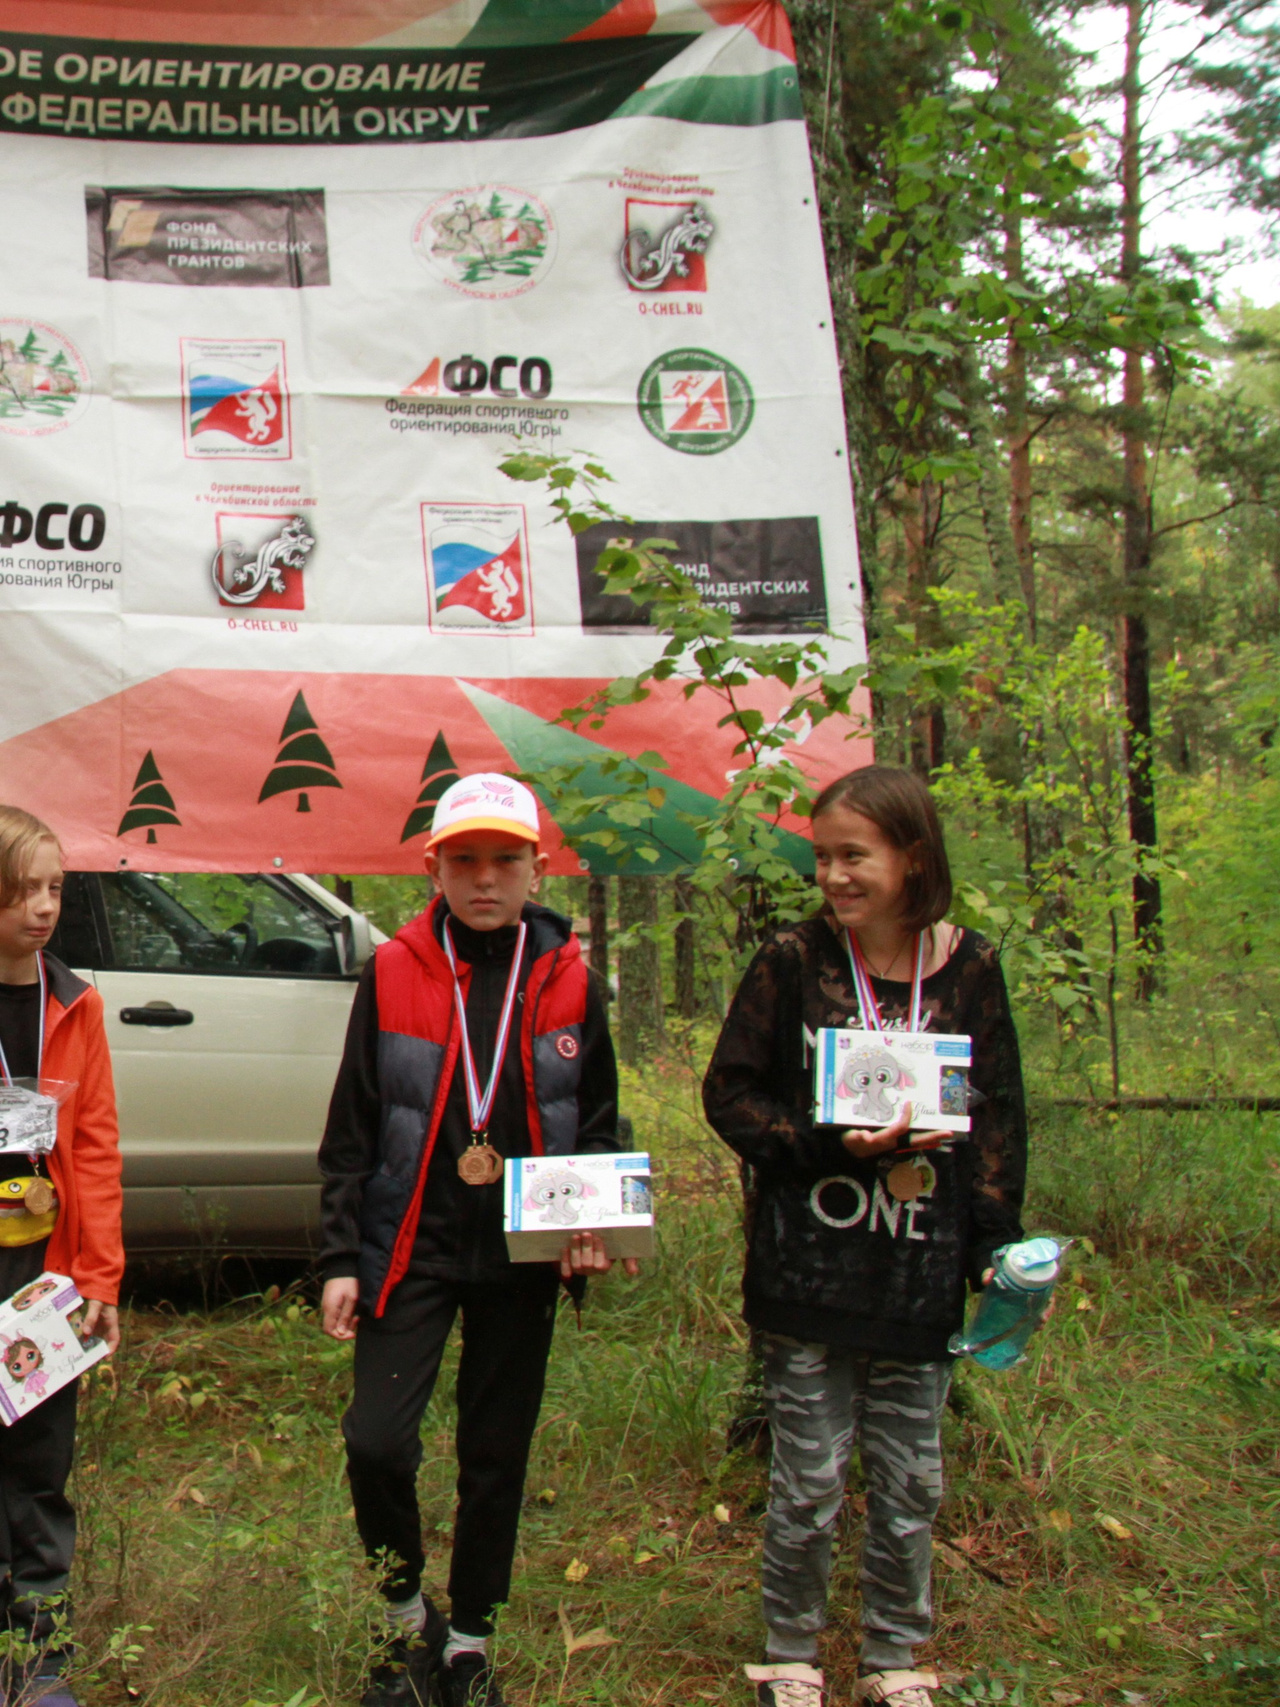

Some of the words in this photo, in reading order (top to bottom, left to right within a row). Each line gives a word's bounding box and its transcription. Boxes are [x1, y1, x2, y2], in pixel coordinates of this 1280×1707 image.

[54, 53, 486, 92] ОРИЕНТИРОВАНИЕ
[1, 91, 341, 136] ФЕДЕРАЛЬНЫЙ
[353, 104, 490, 135] ОКРУГ
[166, 221, 218, 236] ФОНД
[166, 236, 313, 255] ПРЕЗИДЕНТСКИХ
[167, 254, 246, 270] ГРАНТОВ
[638, 301, 704, 316] O-CHEL.RU
[442, 353, 553, 400] ФСО
[384, 398, 471, 418] Федерация
[475, 403, 570, 421] спортивного
[390, 417, 516, 436] ориентирования
[519, 419, 562, 439] Югры
[18, 556, 122, 575] спортивного
[661, 562, 711, 579] ОНД
[67, 573, 115, 594] Югры
[227, 618, 299, 633] O-CHEL.RU
[809, 1174, 928, 1241] ONE
